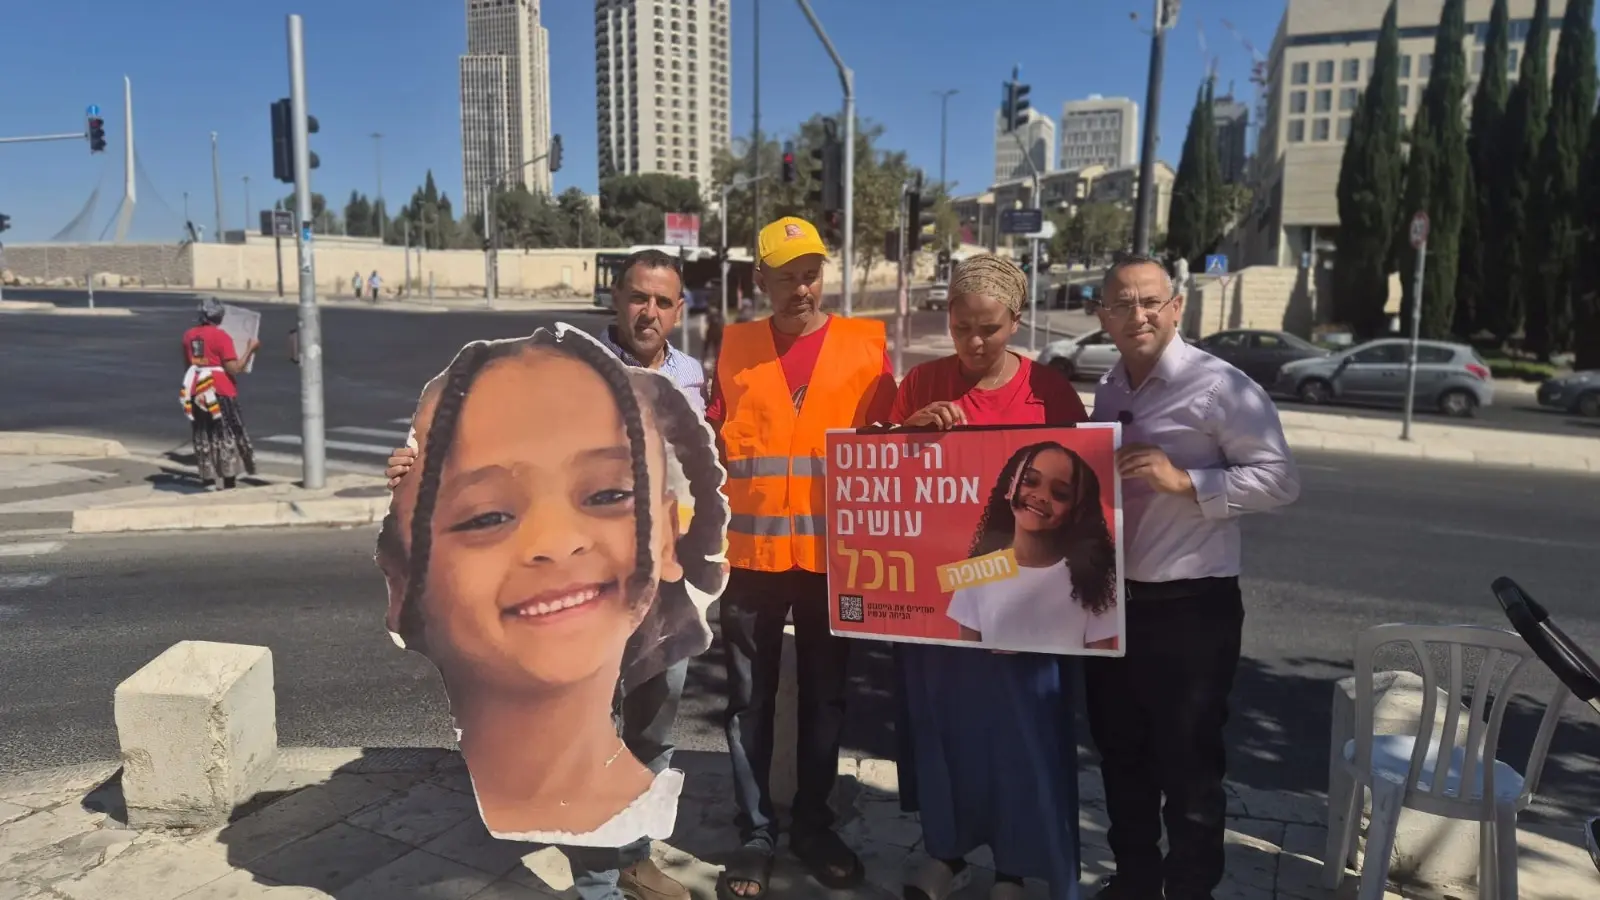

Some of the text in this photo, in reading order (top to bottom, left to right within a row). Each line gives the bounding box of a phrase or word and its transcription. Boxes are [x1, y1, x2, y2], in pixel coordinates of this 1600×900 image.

[835, 442, 942, 469] היימנוט
[835, 476, 980, 504] אמא ואבא
[837, 509, 922, 537] עושים
[837, 540, 915, 593] הכל
[946, 555, 1011, 586] חטופה
